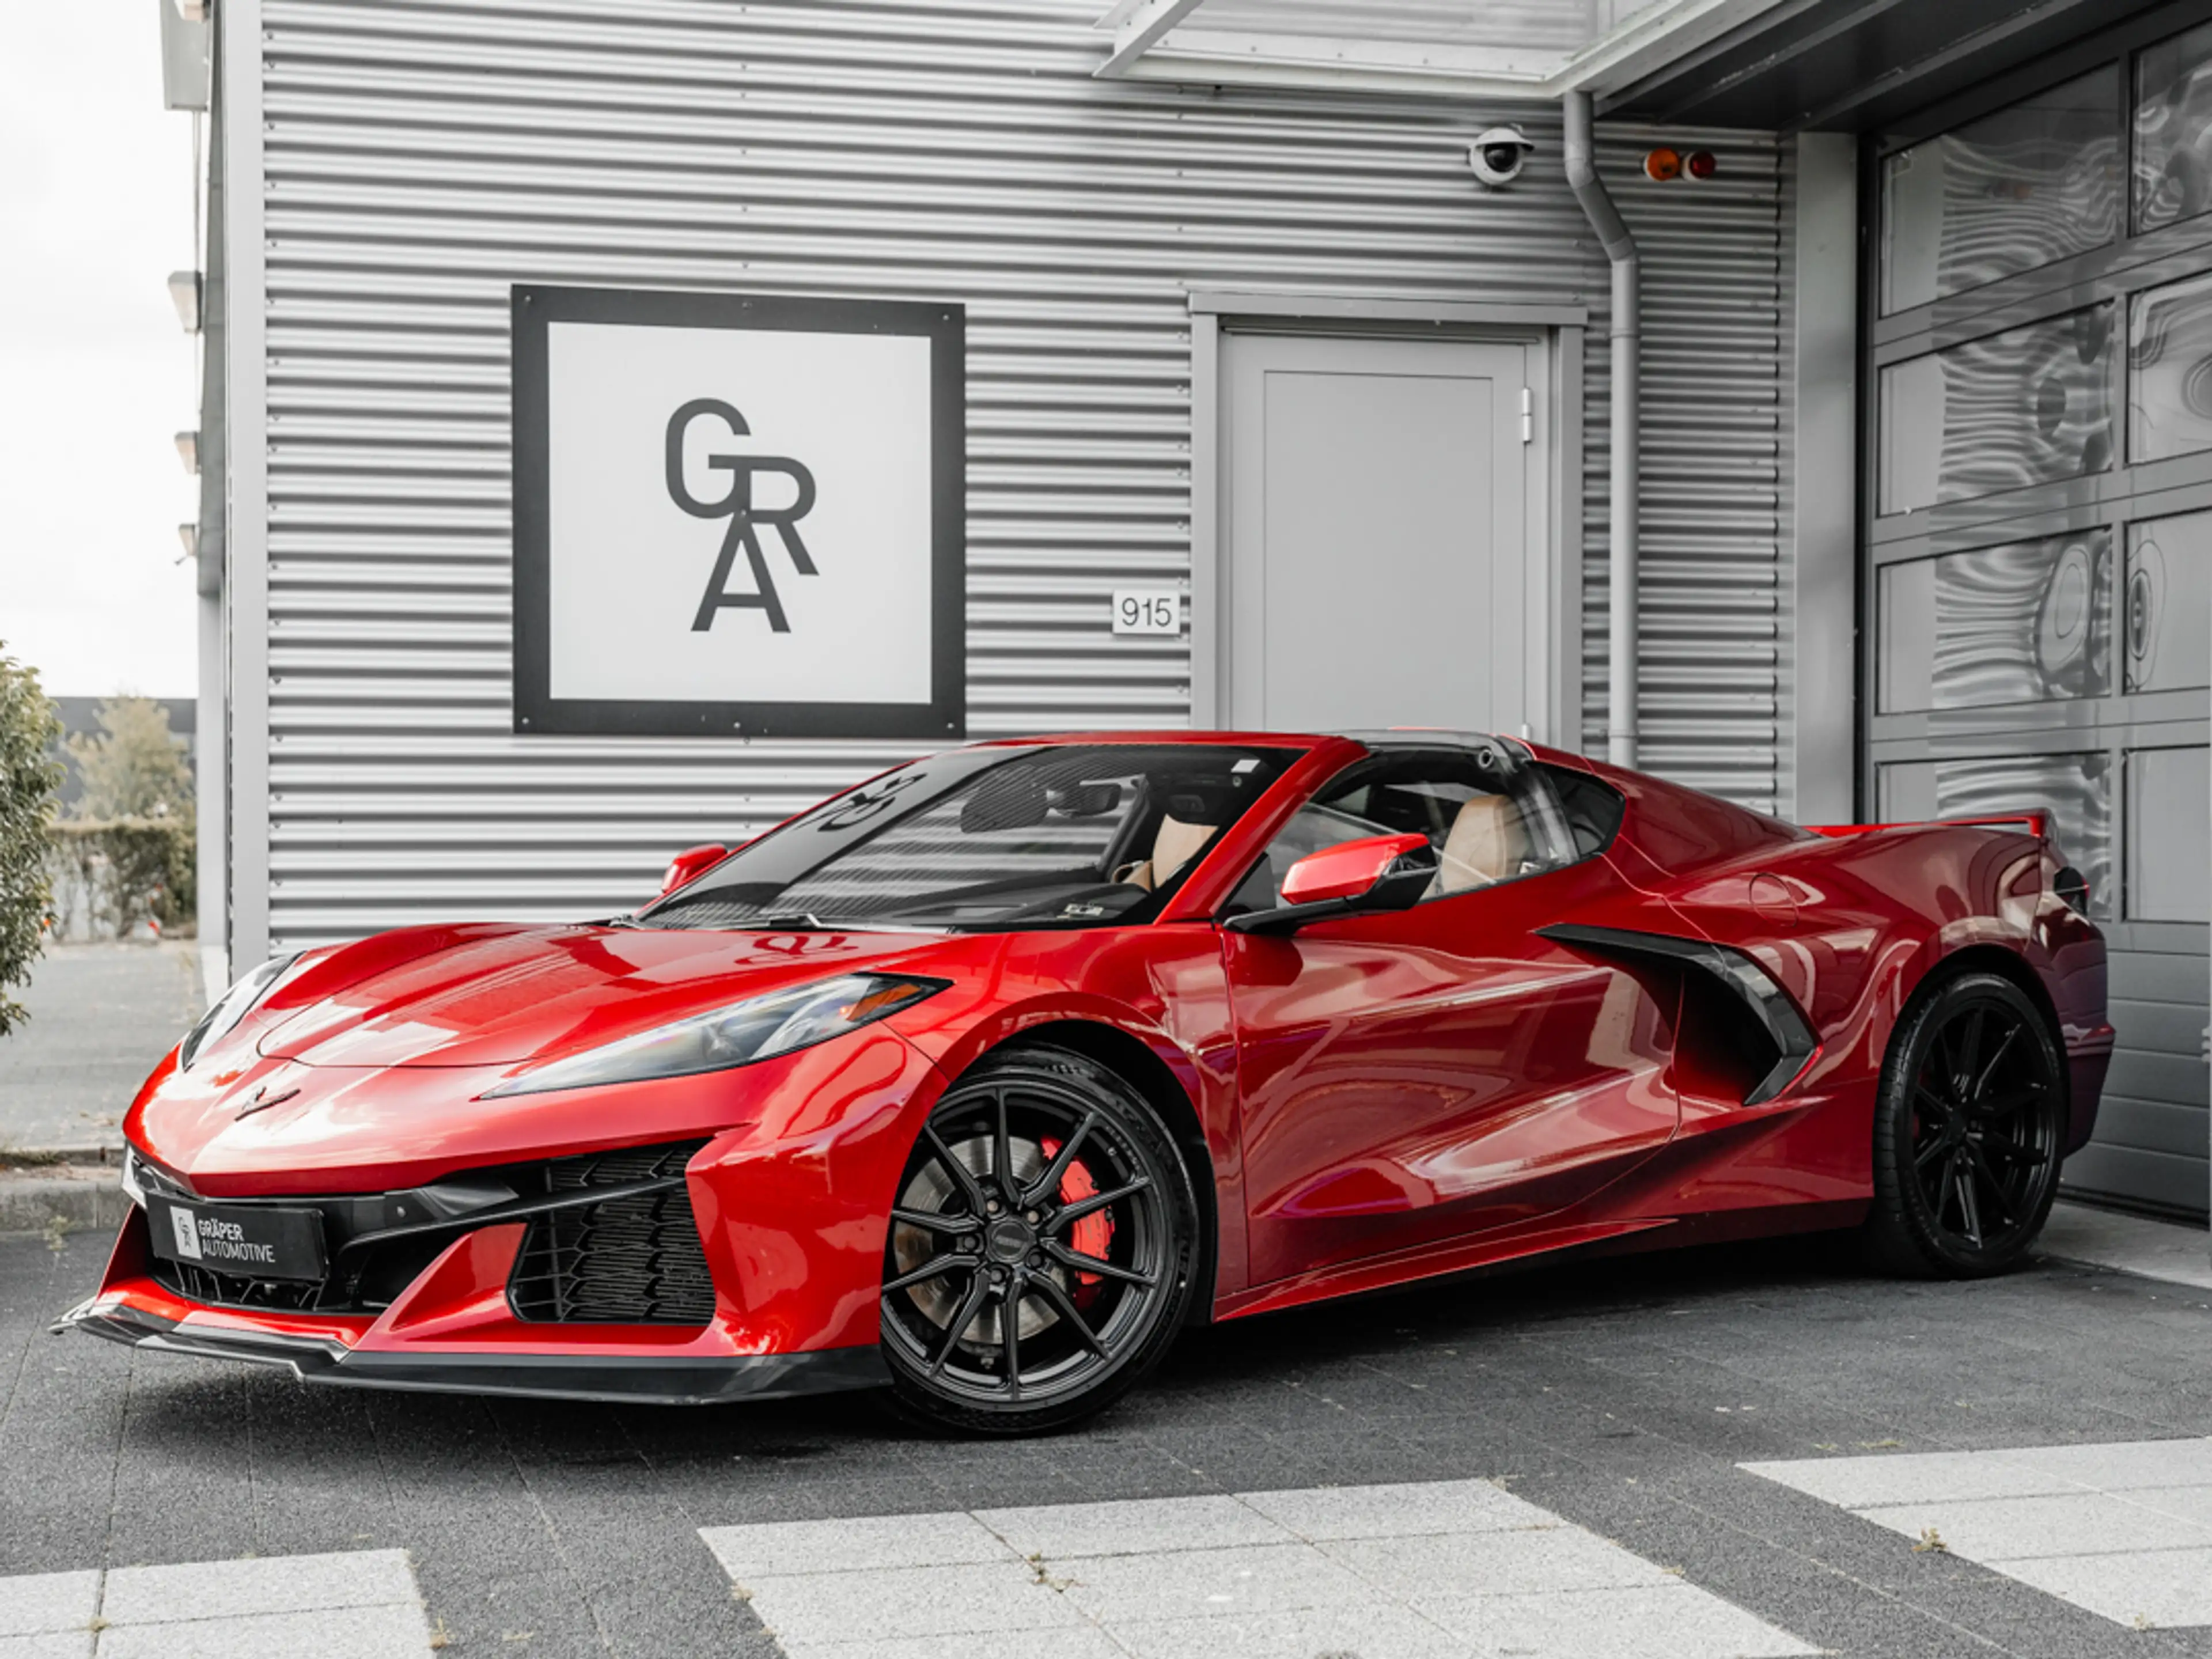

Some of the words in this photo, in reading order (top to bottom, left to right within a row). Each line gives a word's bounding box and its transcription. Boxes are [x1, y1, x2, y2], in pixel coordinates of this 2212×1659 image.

[1122, 597, 1172, 627] 915
[198, 1217, 244, 1241] GRÄPER
[202, 1238, 276, 1263] AUTOMOTIVE
